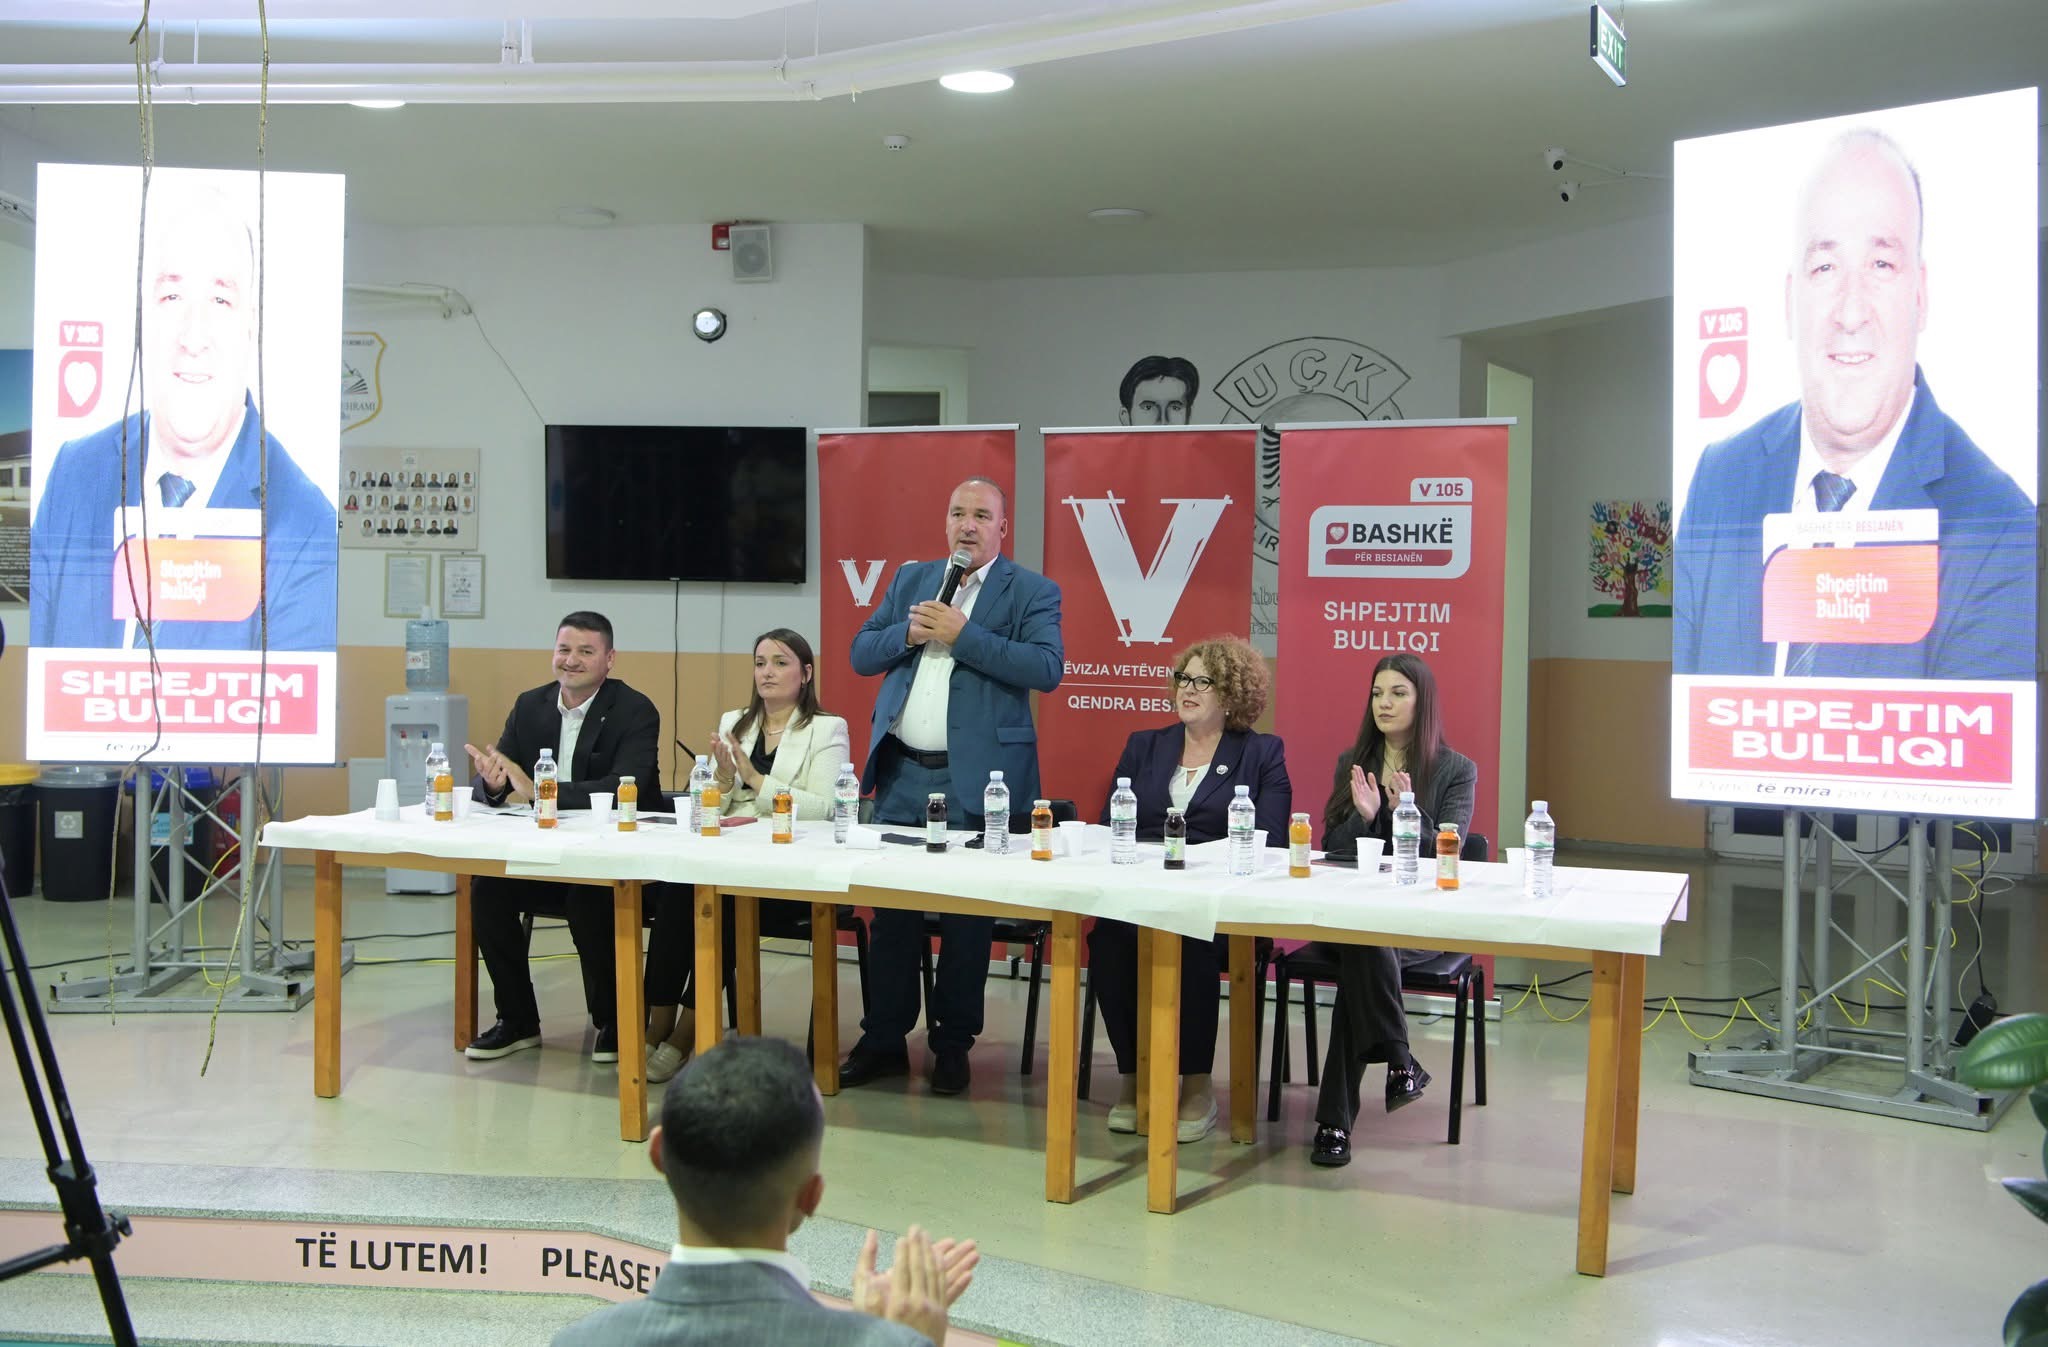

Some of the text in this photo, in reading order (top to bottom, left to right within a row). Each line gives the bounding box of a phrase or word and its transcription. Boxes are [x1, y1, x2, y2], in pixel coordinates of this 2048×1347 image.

[1601, 24, 1623, 69] EXIT
[63, 325, 76, 343] V
[1704, 312, 1743, 335] V 105
[1234, 349, 1387, 408] UÇK
[1418, 483, 1464, 497] V 105
[1352, 517, 1453, 544] BASHKË
[1061, 490, 1233, 647] V
[1354, 550, 1423, 563] PËR BESIANËN
[1816, 573, 1888, 600] Shpejtim
[1323, 600, 1451, 624] SHPEJTIM
[1816, 598, 1871, 624] Bulliqi
[1333, 629, 1440, 653] BULLIQI
[1063, 660, 1175, 678] ËVIZJA VETËVEN
[60, 670, 304, 698] SHPEJTIM
[84, 697, 281, 725] BULLIQI
[1067, 695, 1177, 713] QENDRA BES
[1706, 697, 1993, 736] SHPEJTIM
[1732, 730, 1964, 769] BULLIQI
[1756, 782, 1777, 794] të
[1783, 783, 1831, 797] mira
[296, 1231, 337, 1269] TË
[350, 1240, 488, 1275] LUTEM!
